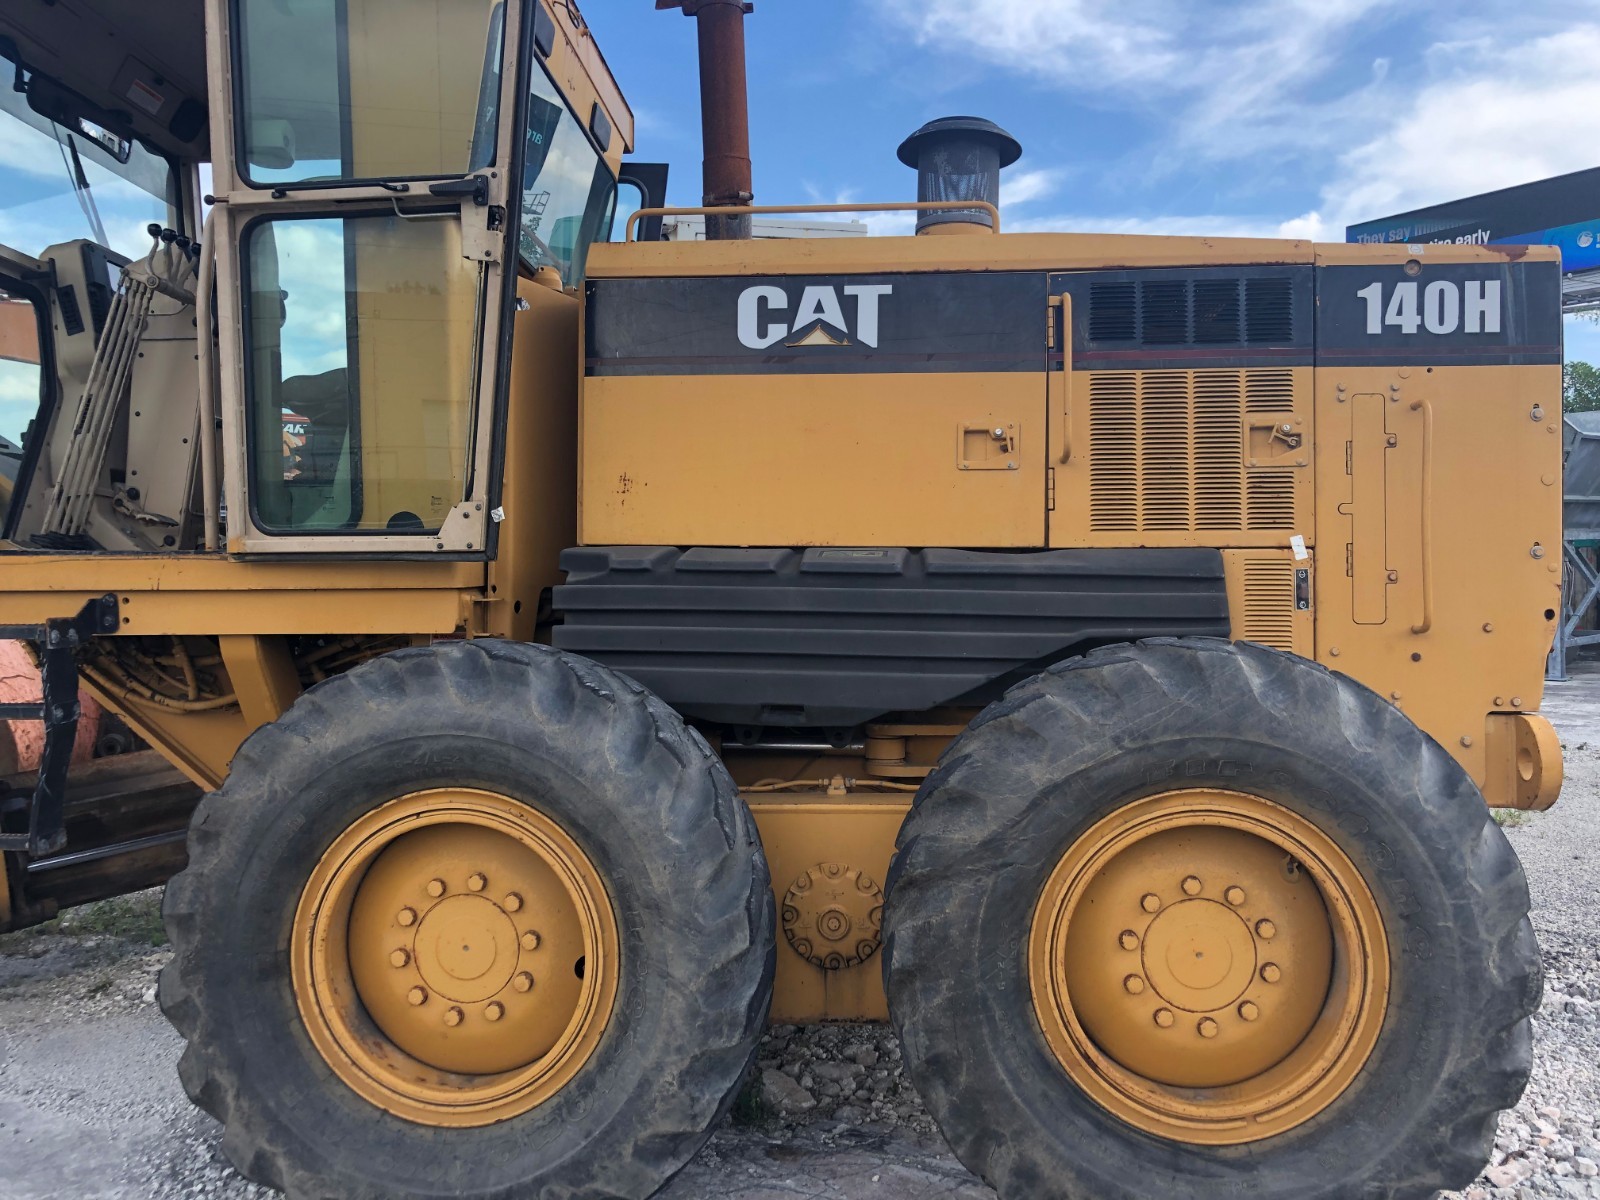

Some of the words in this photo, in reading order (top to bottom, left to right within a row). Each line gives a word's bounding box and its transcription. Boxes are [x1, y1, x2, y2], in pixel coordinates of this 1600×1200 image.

[1356, 231, 1386, 244] They
[1388, 227, 1412, 243] say
[1455, 229, 1491, 244] early
[737, 284, 893, 350] CAT
[1357, 279, 1501, 334] 140H
